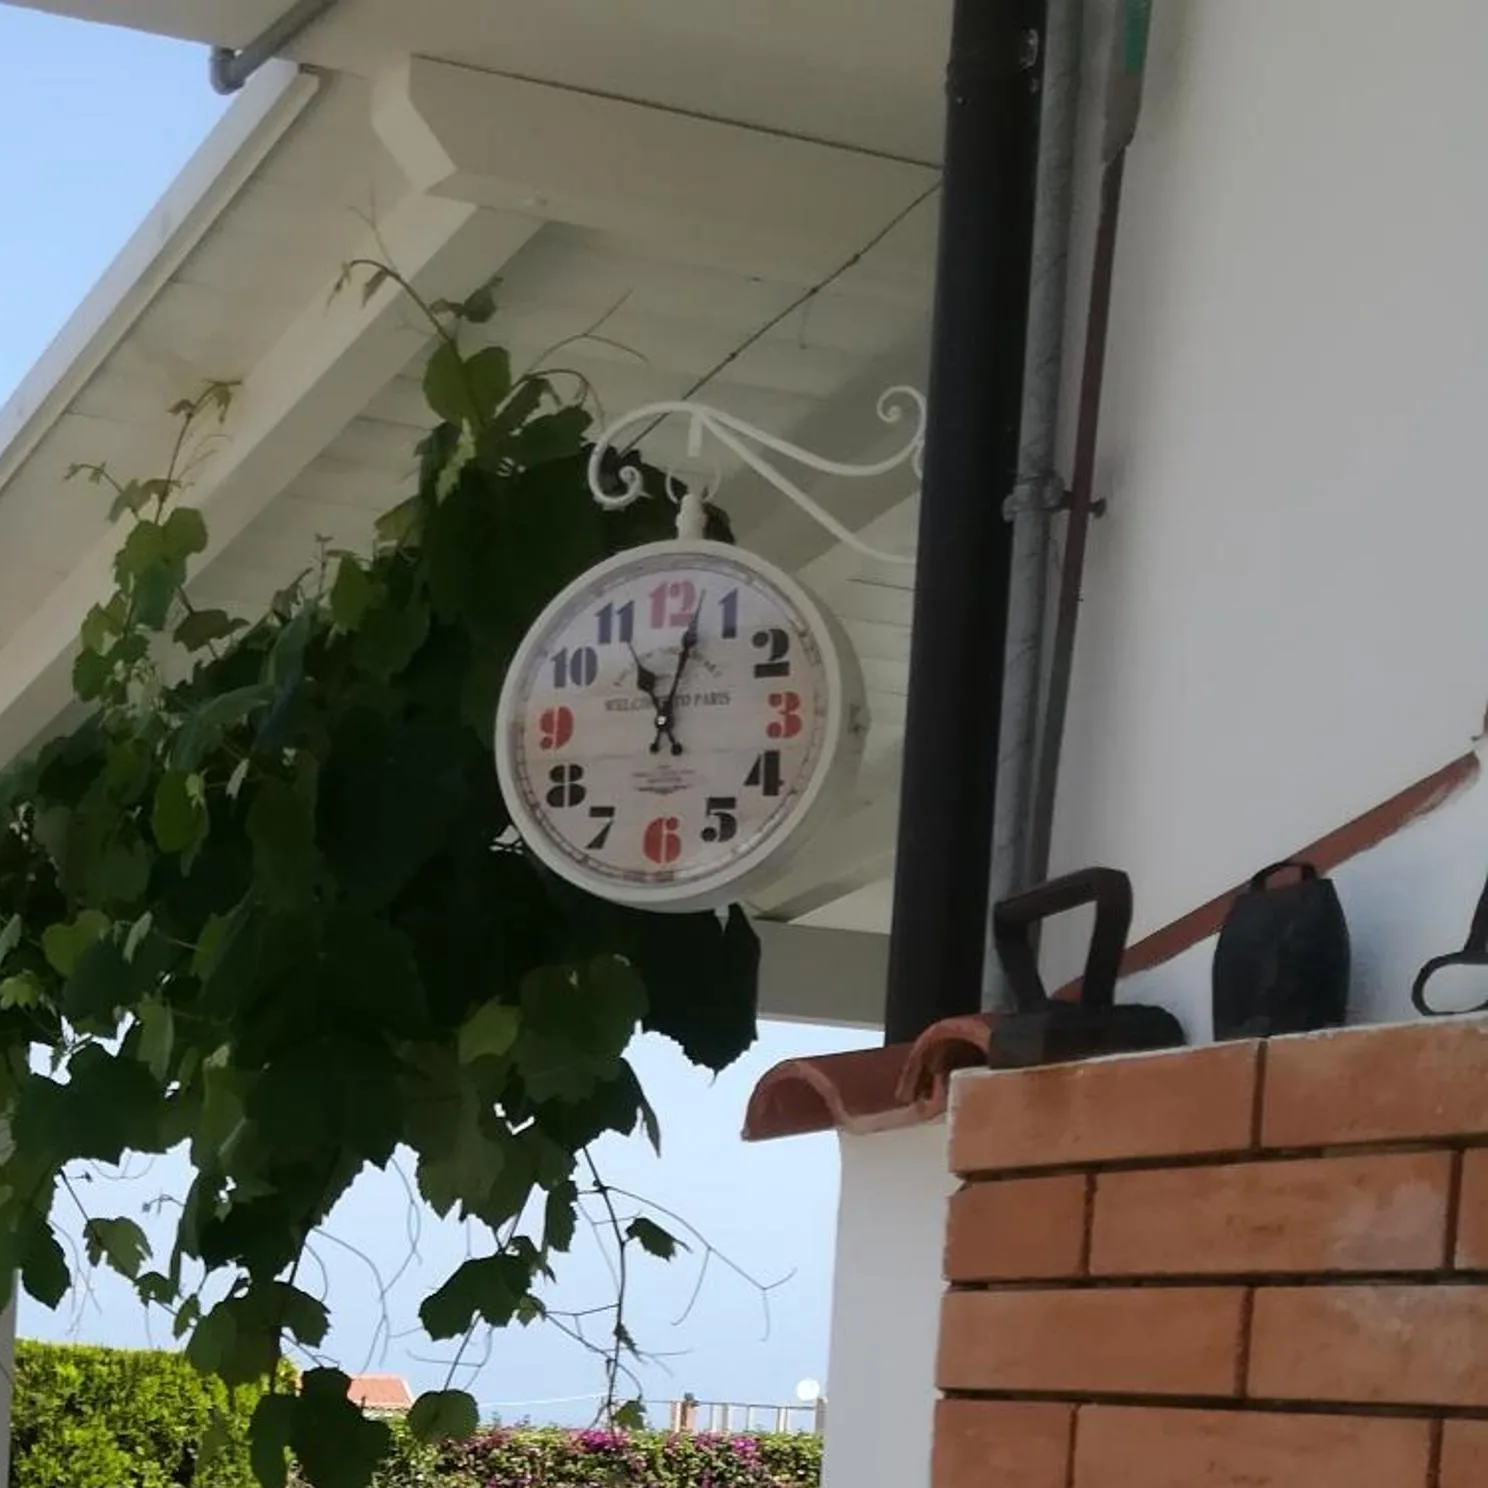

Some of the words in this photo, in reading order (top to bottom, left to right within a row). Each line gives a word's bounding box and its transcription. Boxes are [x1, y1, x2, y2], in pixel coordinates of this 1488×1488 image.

[595, 600, 635, 644] 11
[649, 580, 696, 630] 12
[718, 588, 739, 639] 1
[550, 646, 598, 688] 10
[752, 628, 790, 679] 2
[539, 706, 574, 750] 9
[766, 691, 802, 739] 3
[545, 763, 587, 808] 8
[743, 750, 785, 796] 4
[586, 806, 616, 850] 7
[642, 816, 682, 864] 6
[700, 796, 738, 842] 5
